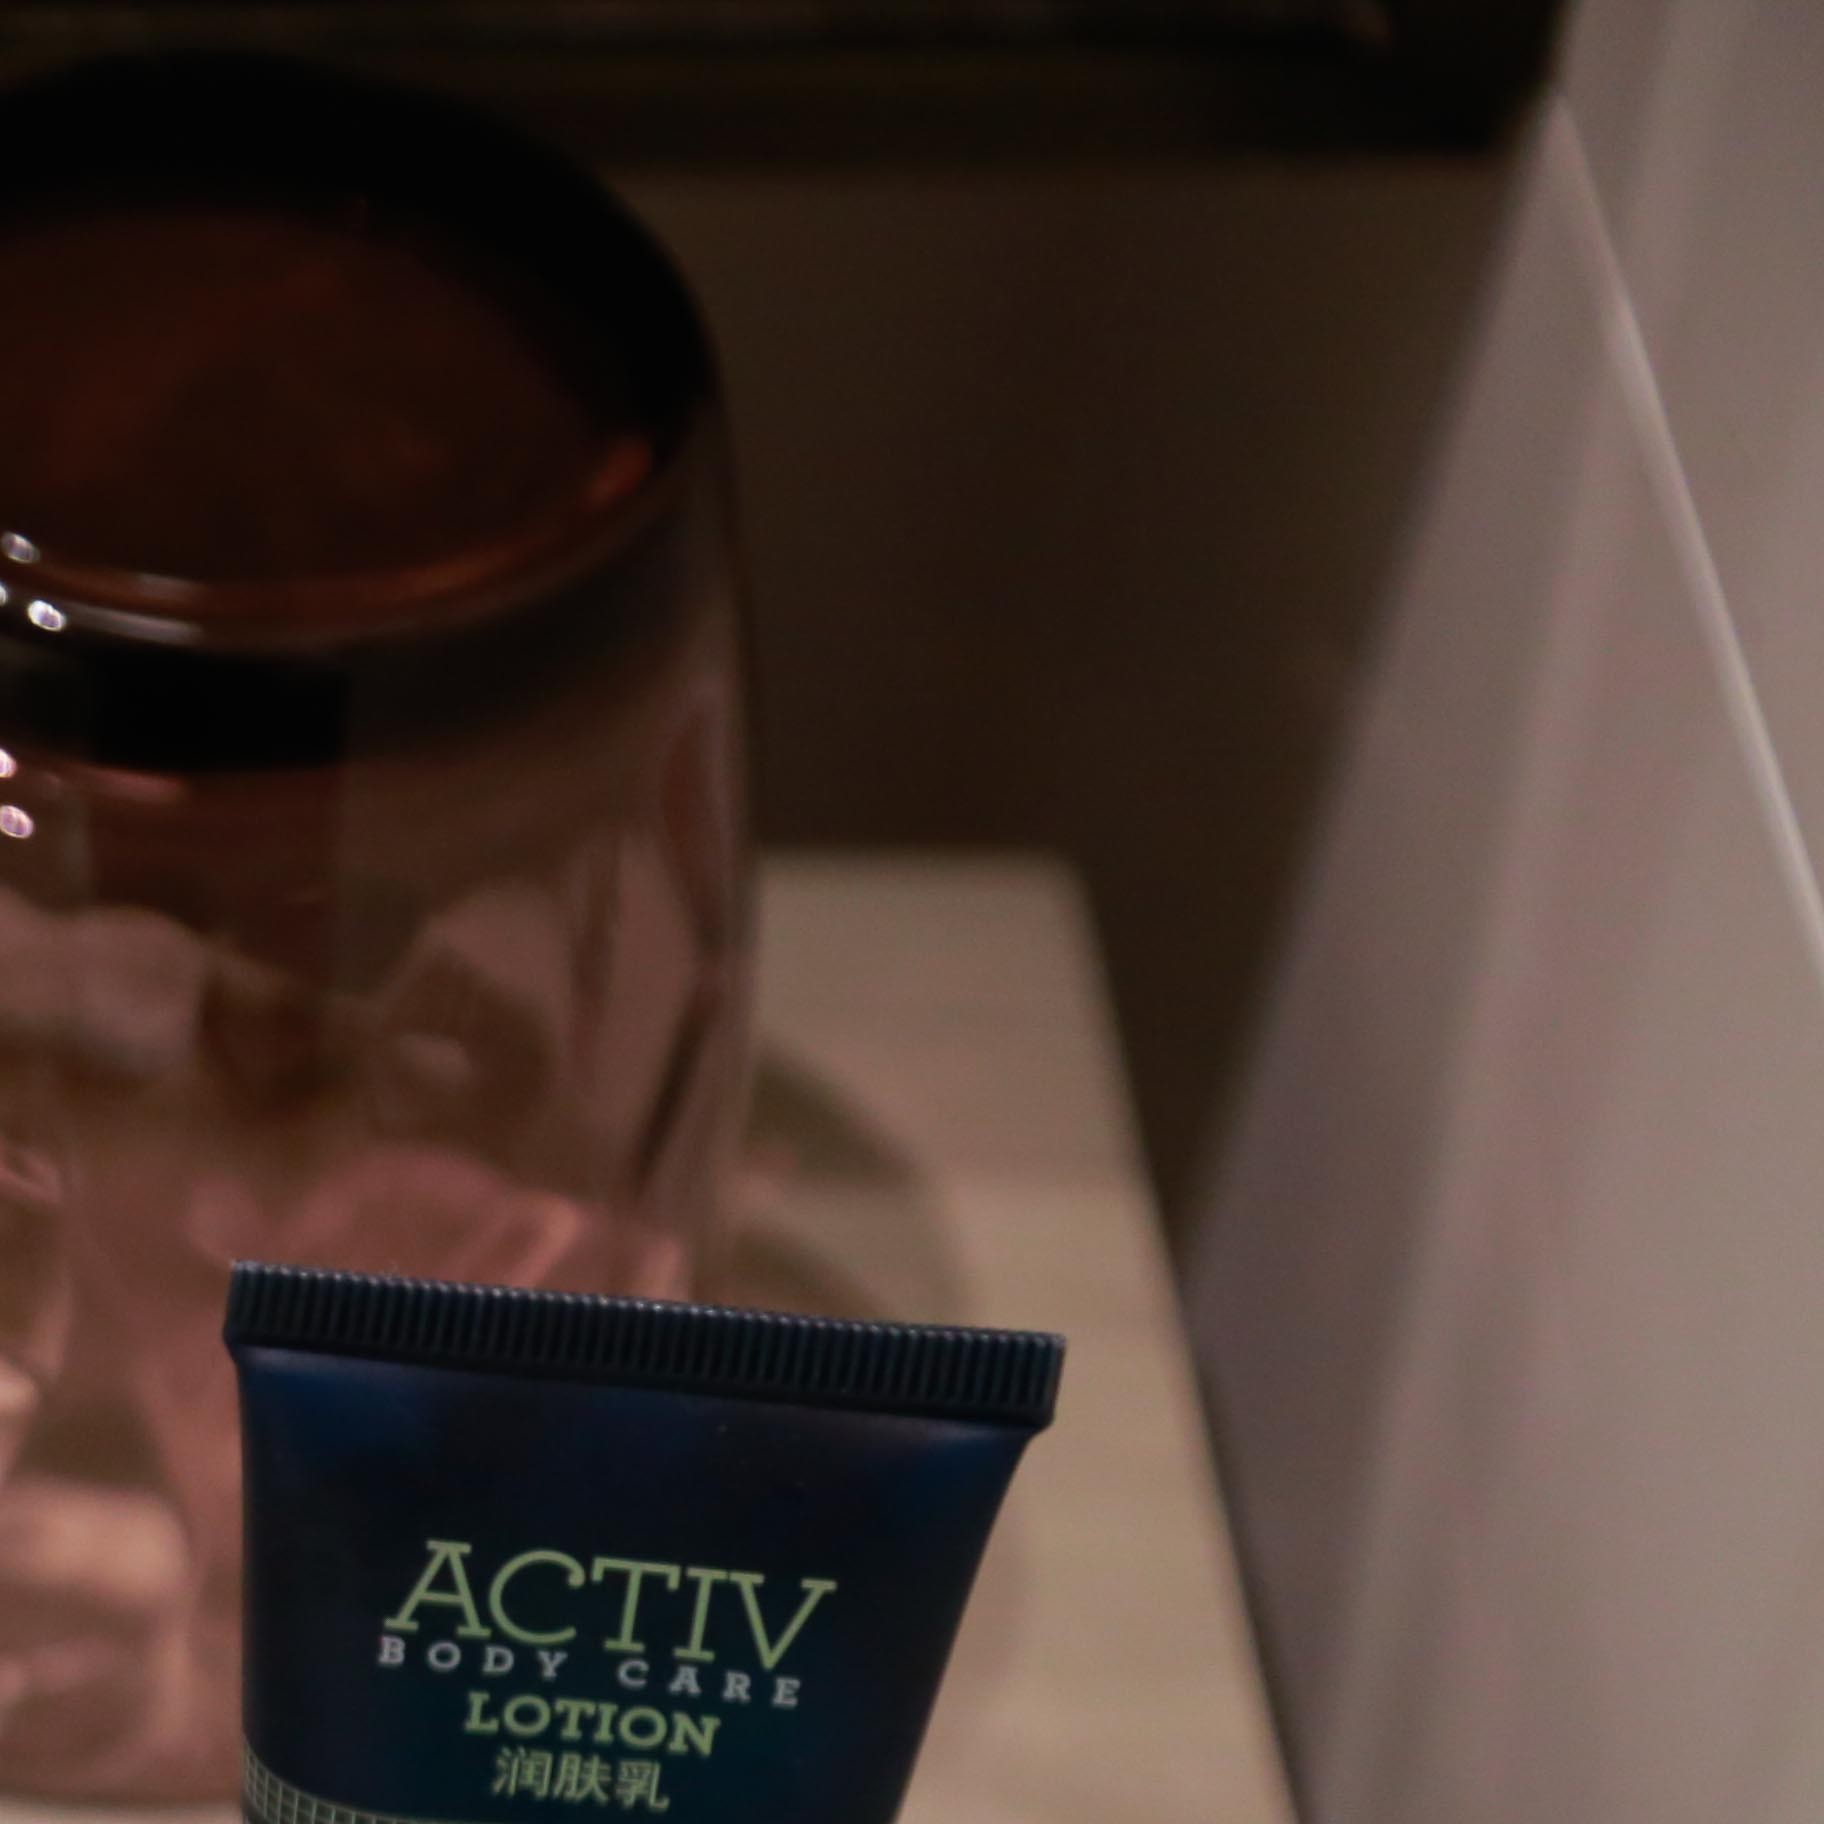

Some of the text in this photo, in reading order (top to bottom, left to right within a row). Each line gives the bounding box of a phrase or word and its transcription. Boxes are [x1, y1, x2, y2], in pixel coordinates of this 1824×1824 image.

[383, 1537, 838, 1671] ACTIV
[377, 1635, 801, 1708] BODY CARE
[463, 1690, 721, 1758] LOTION
[492, 1745, 670, 1812] 润肤乳
